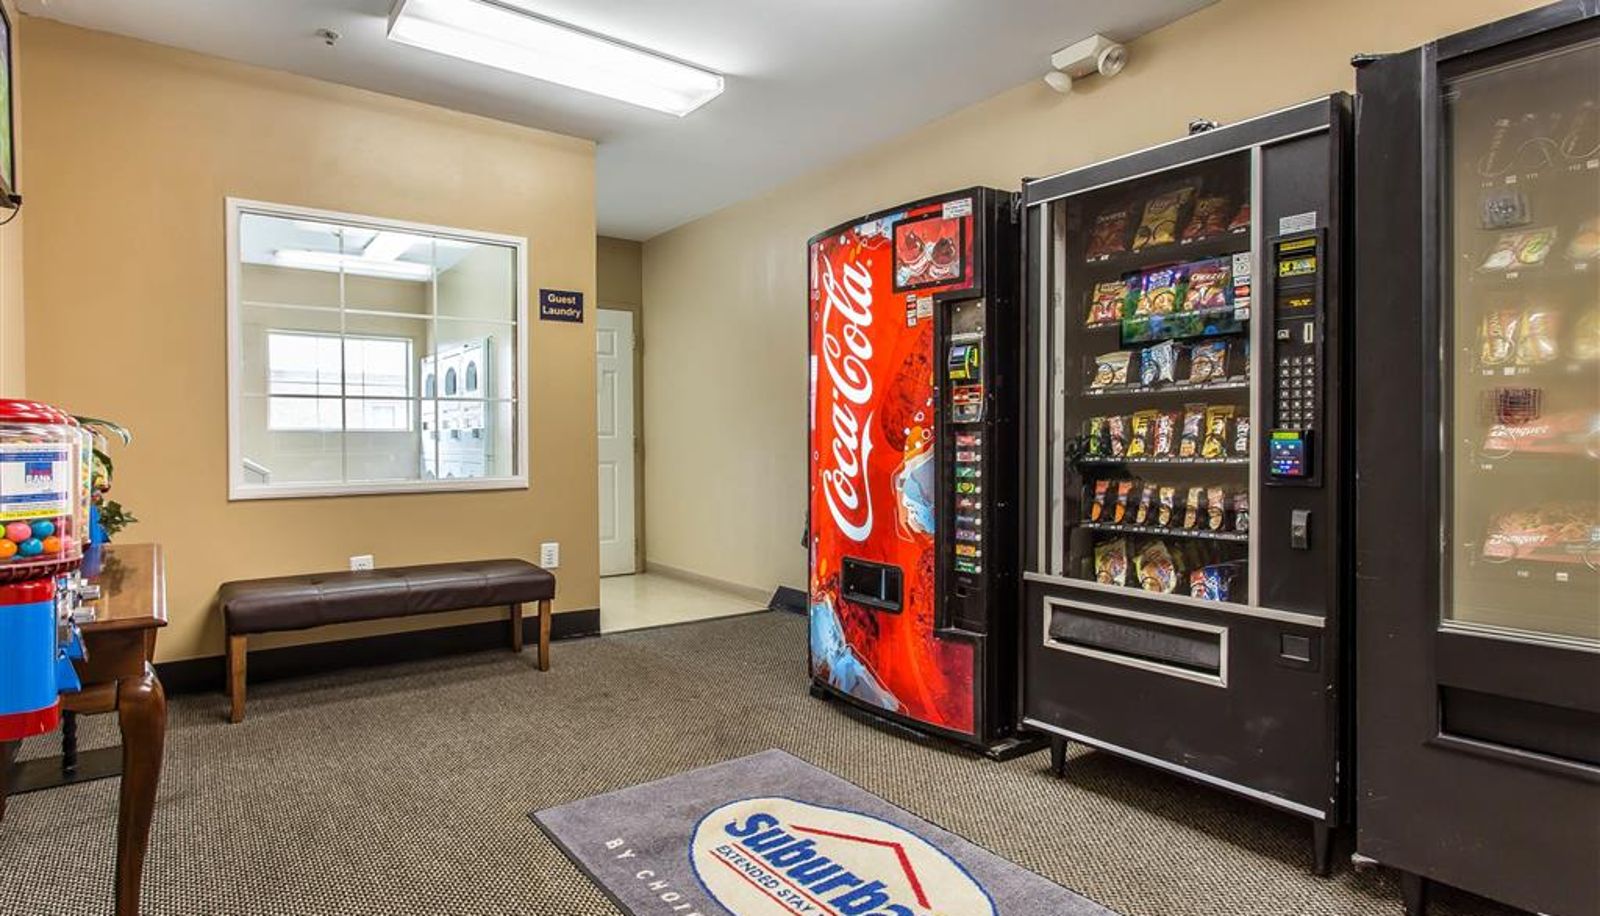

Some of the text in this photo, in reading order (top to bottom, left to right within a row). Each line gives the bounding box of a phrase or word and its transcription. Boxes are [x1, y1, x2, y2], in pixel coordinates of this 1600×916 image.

[542, 305, 582, 319] Laundry
[547, 293, 576, 305] Guest
[823, 254, 873, 542] Coca-Cola
[605, 838, 704, 916] BY CHOI
[716, 844, 815, 912] EXTENDED STAY
